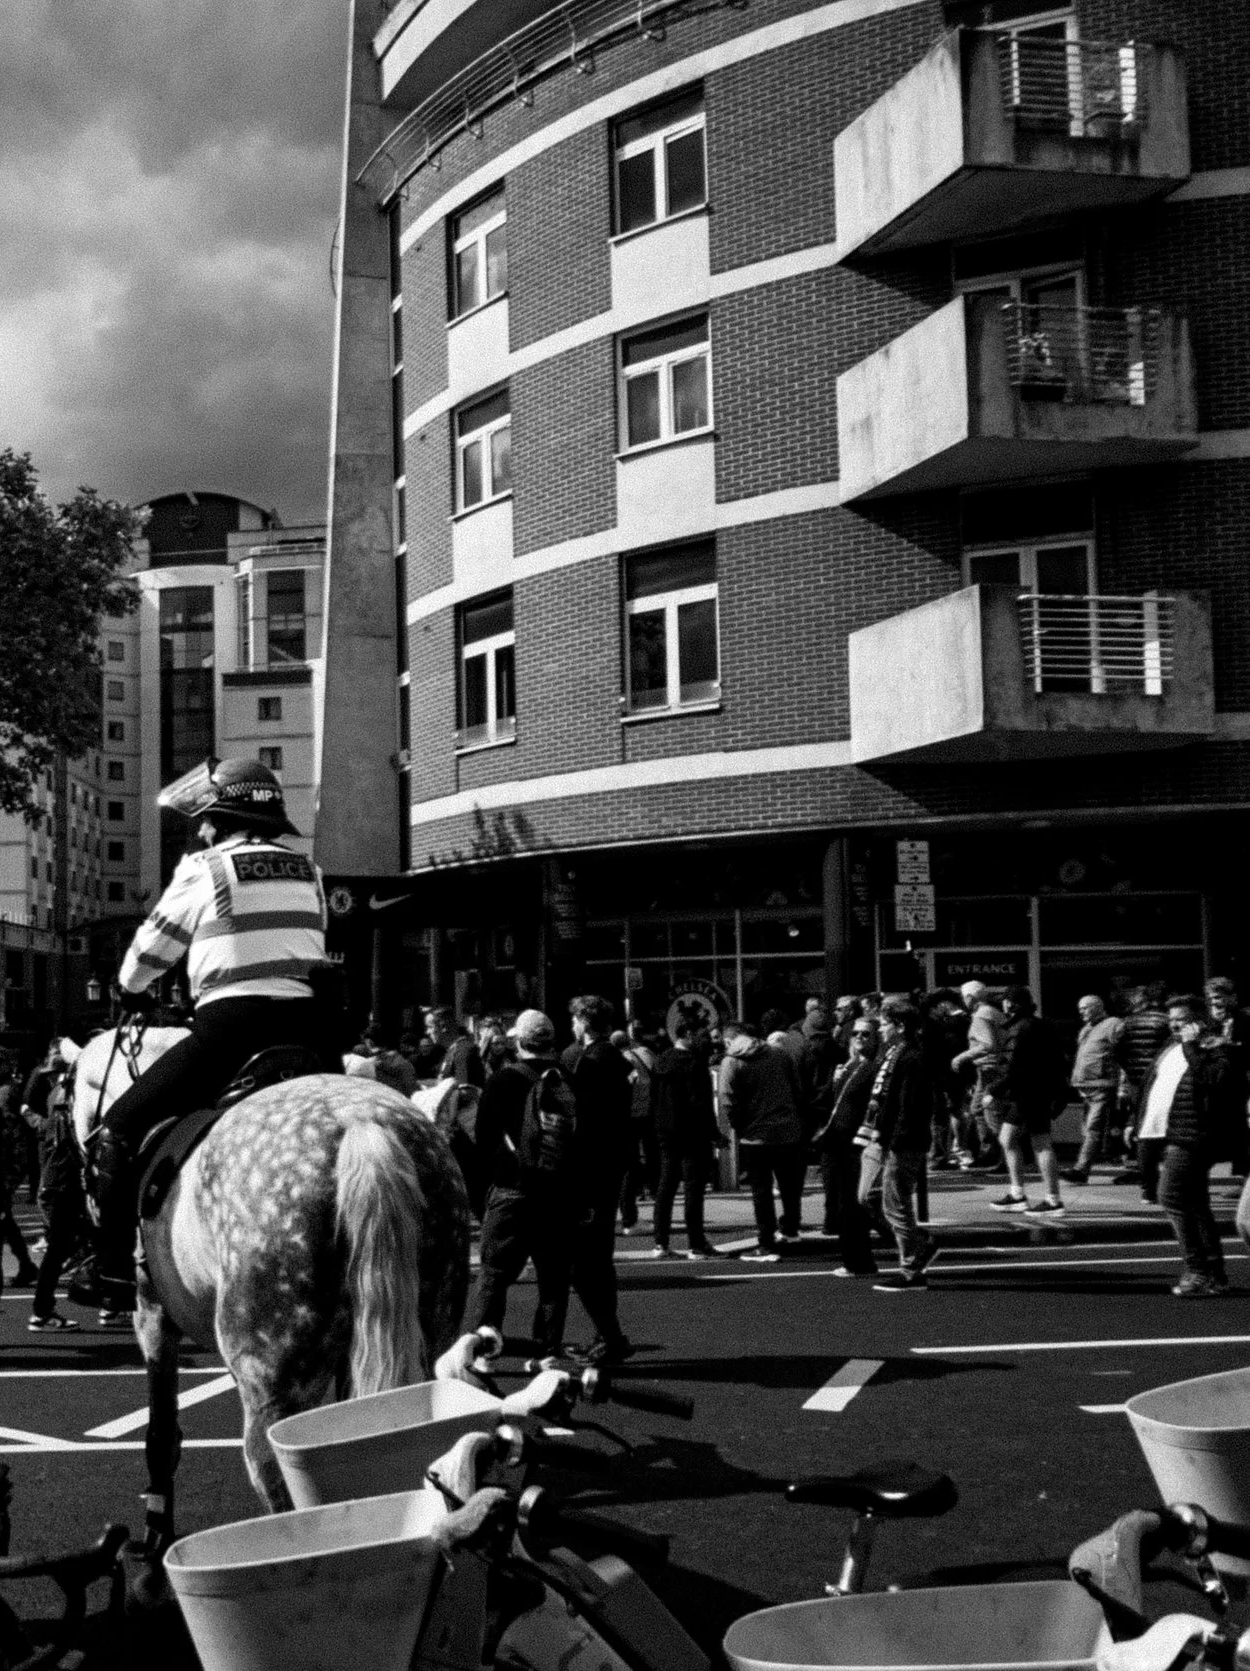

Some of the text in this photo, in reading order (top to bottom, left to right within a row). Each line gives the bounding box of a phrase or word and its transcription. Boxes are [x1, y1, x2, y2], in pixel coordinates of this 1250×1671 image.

[252, 789, 273, 802] MP
[238, 862, 310, 879] POLICE
[947, 962, 1017, 975] ENTRANCE
